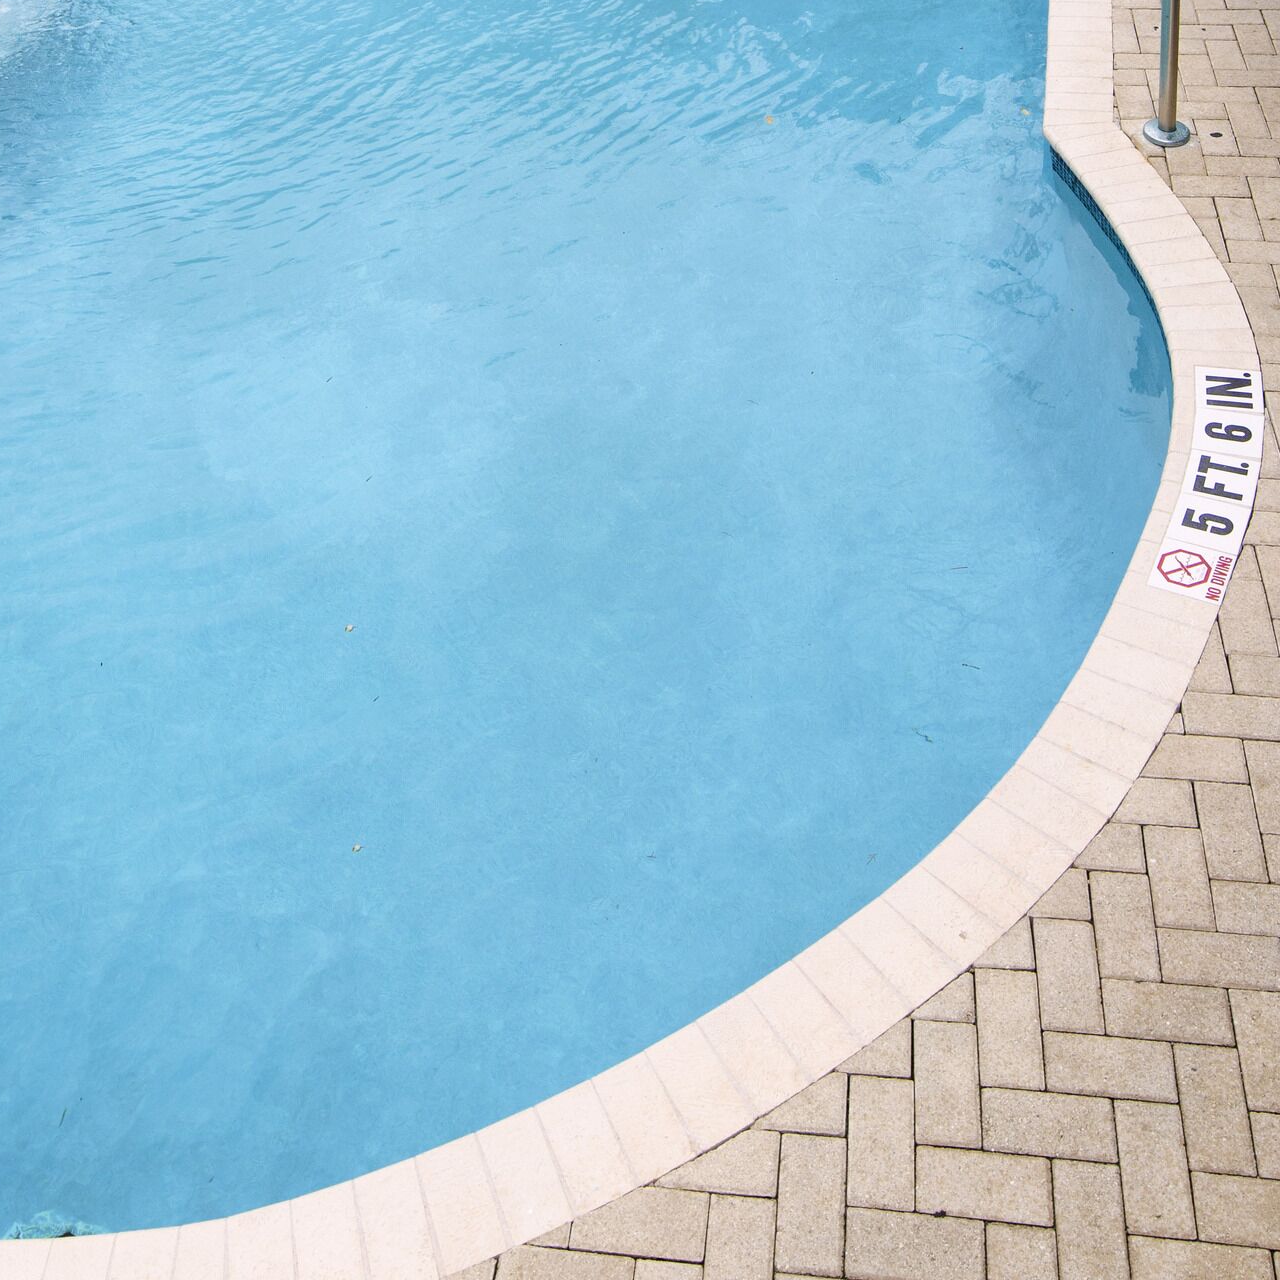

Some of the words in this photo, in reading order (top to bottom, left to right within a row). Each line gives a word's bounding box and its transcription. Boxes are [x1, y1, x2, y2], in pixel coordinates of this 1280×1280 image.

[1205, 372, 1253, 409] IN.
[1205, 422, 1252, 442] 6
[1193, 454, 1250, 501] FT.
[1181, 508, 1234, 536] 5
[1211, 556, 1233, 586] DIVING
[1205, 587, 1221, 601] NO
